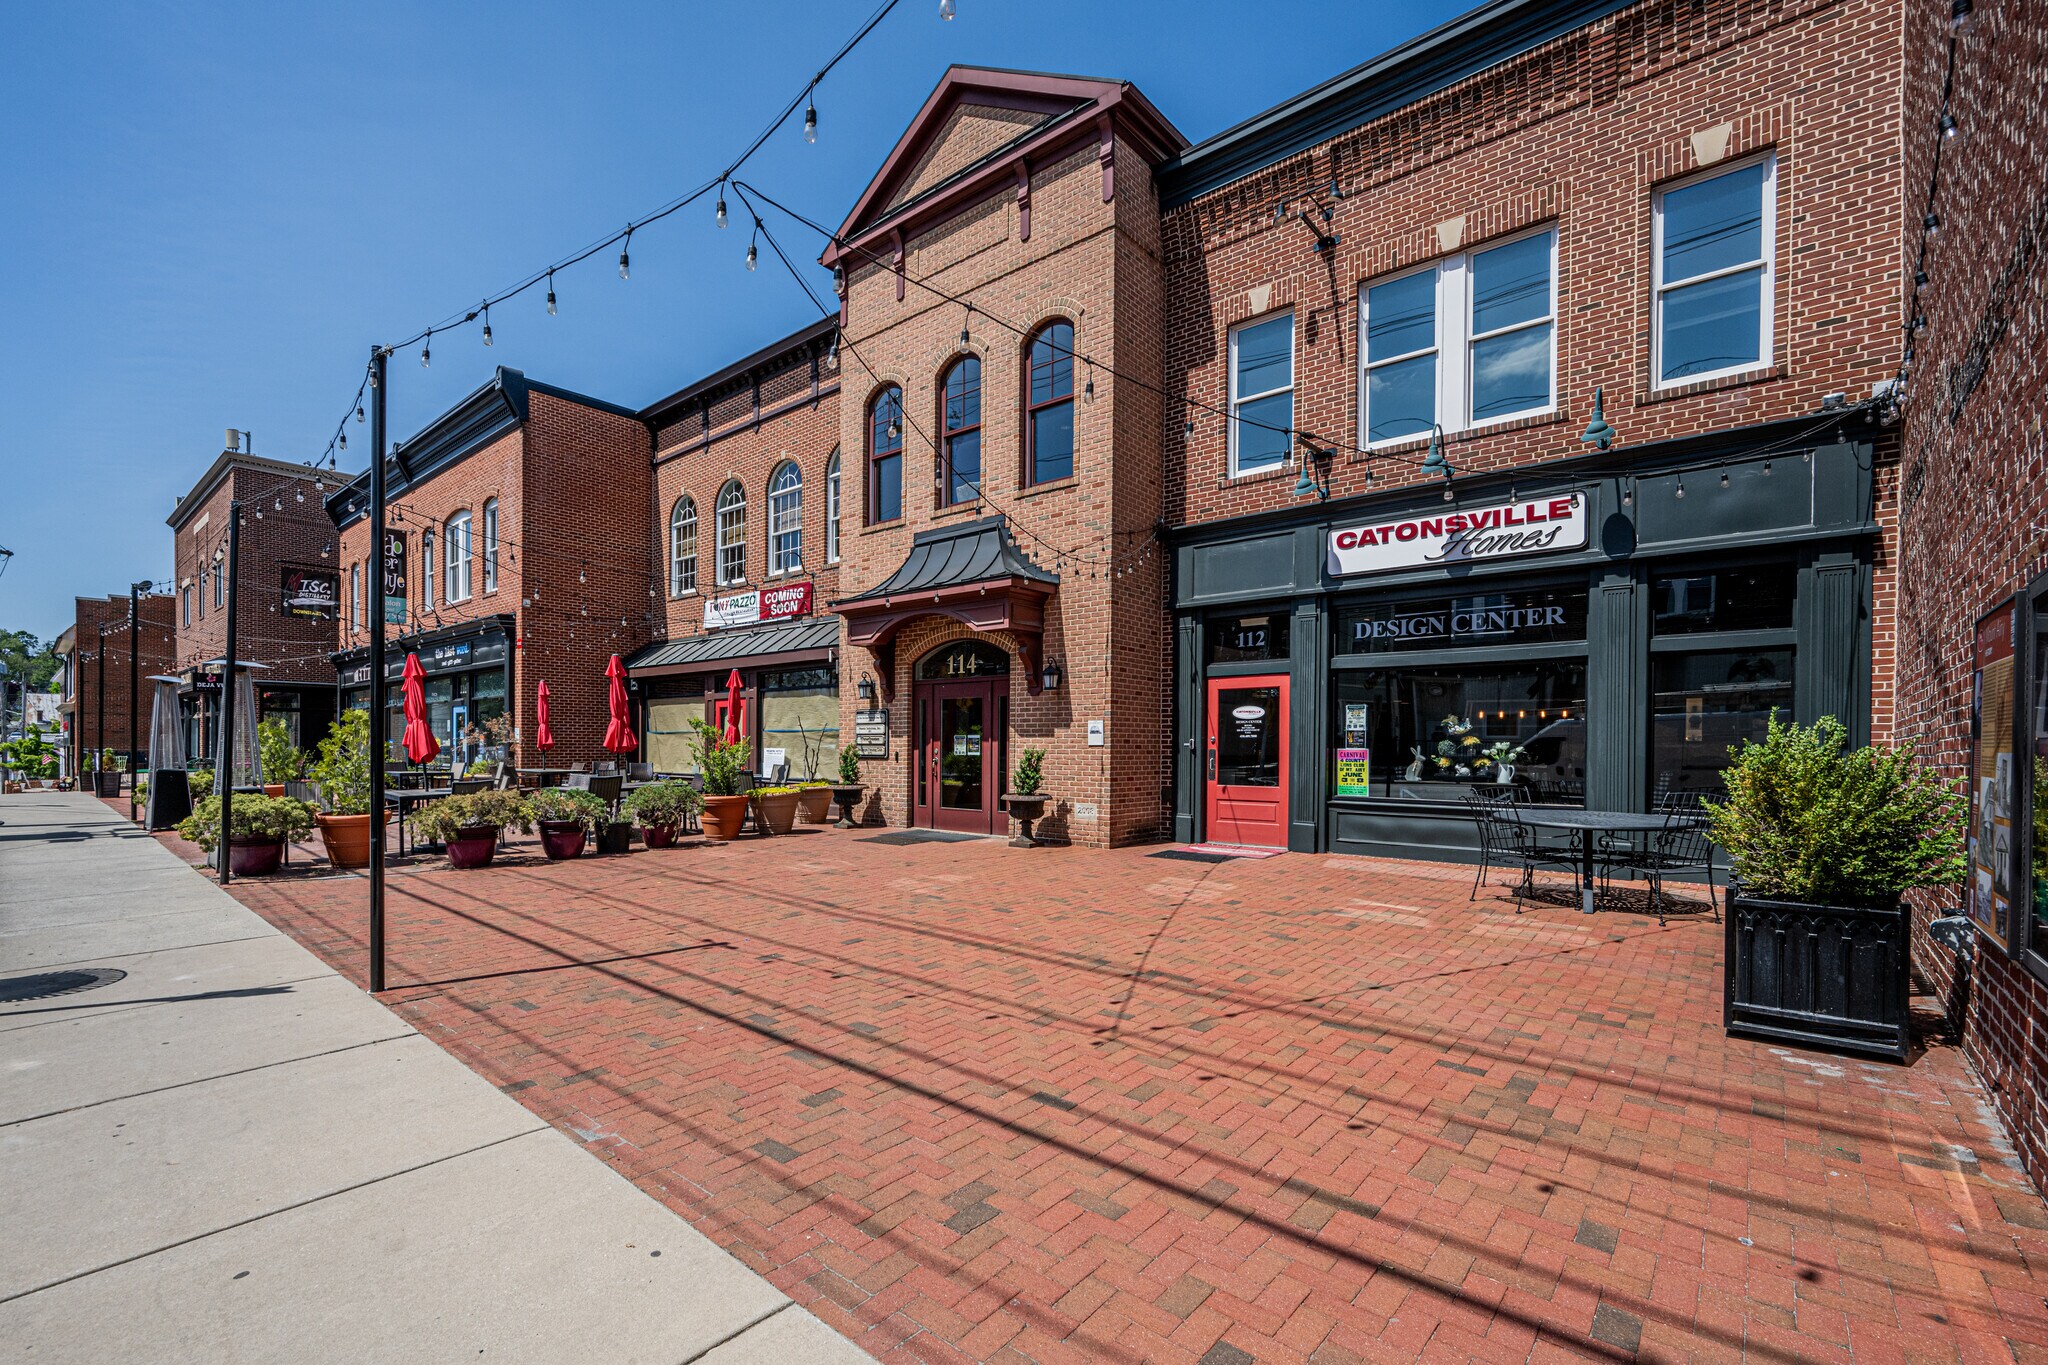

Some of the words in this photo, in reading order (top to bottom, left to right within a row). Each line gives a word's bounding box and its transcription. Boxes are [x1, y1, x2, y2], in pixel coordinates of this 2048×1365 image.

[1336, 498, 1572, 550] CATONSVILLE
[1424, 525, 1562, 561] Homes
[765, 587, 804, 604] COMING
[771, 601, 798, 615] SOON
[1355, 615, 1445, 640] DESIGN
[1451, 606, 1567, 633] CENTER
[1237, 630, 1265, 648] 112
[947, 653, 977, 675] 114
